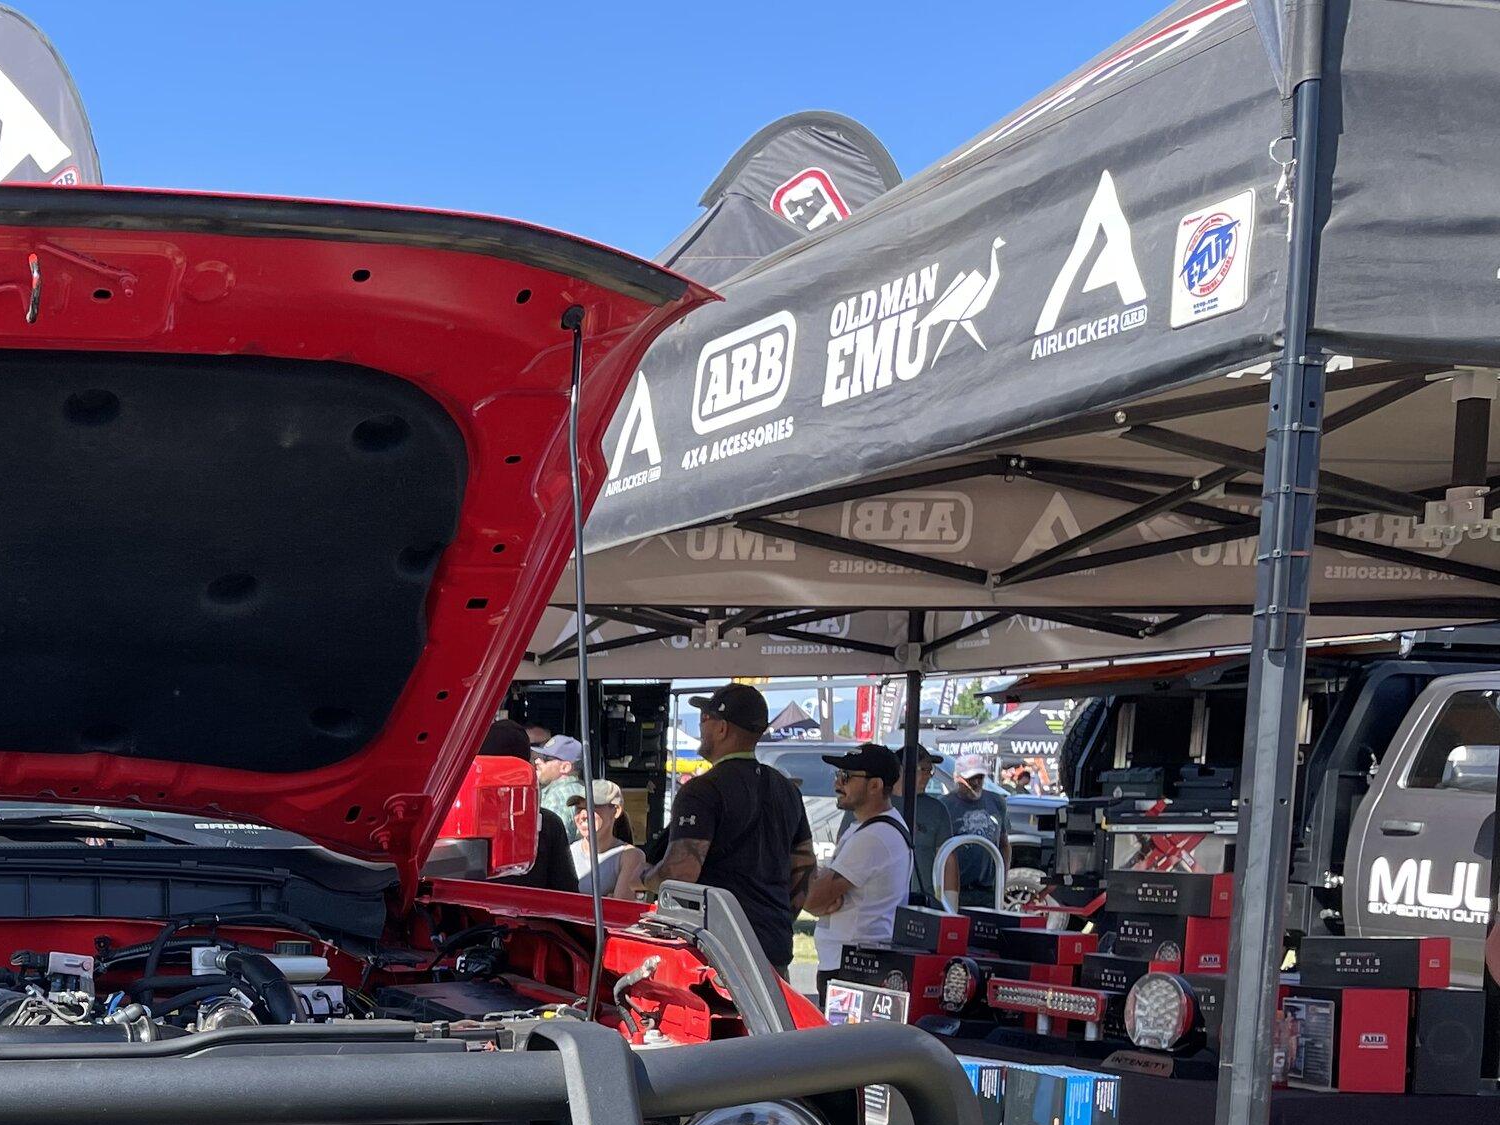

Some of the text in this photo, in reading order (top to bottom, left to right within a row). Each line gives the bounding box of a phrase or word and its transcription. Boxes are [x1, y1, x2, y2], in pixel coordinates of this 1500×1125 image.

[829, 262, 939, 338] OLD MAN
[821, 308, 930, 408] EMU
[1030, 315, 1120, 361] AIRLOCKER
[700, 331, 785, 418] ARB
[681, 415, 794, 471] 4X4 ACCESSORIES
[604, 470, 648, 498] AIRLOCKER
[1368, 856, 1490, 912] MUL
[1367, 901, 1451, 921] EXPEDITION
[1335, 958, 1381, 967] SOLIS
[872, 994, 893, 1015] AIR
[1363, 1035, 1384, 1043] ARB
